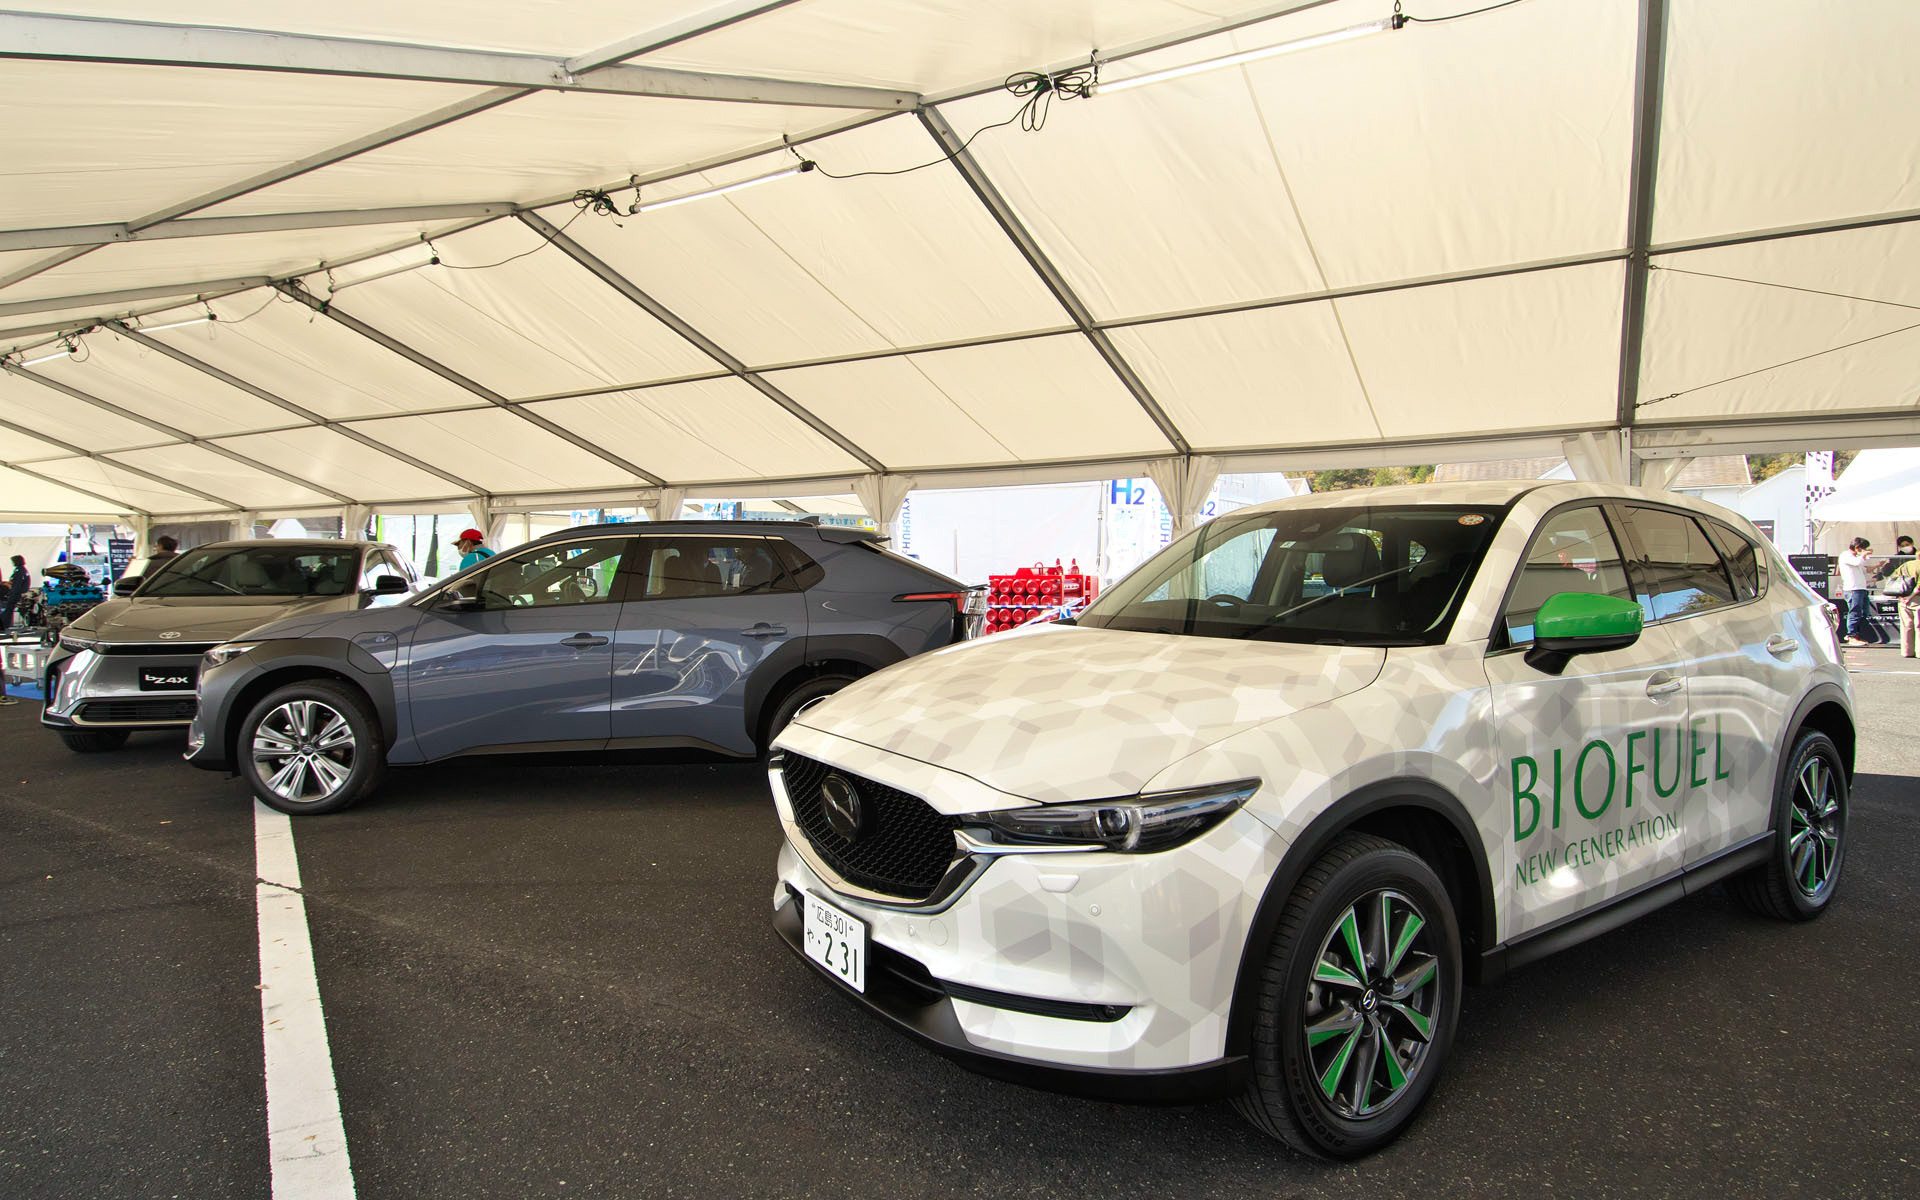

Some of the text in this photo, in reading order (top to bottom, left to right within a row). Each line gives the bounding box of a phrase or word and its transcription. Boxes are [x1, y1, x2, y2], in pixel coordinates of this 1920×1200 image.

[1511, 713, 1730, 843] BIOFUEL
[1516, 811, 1680, 890] NEW GENERATION
